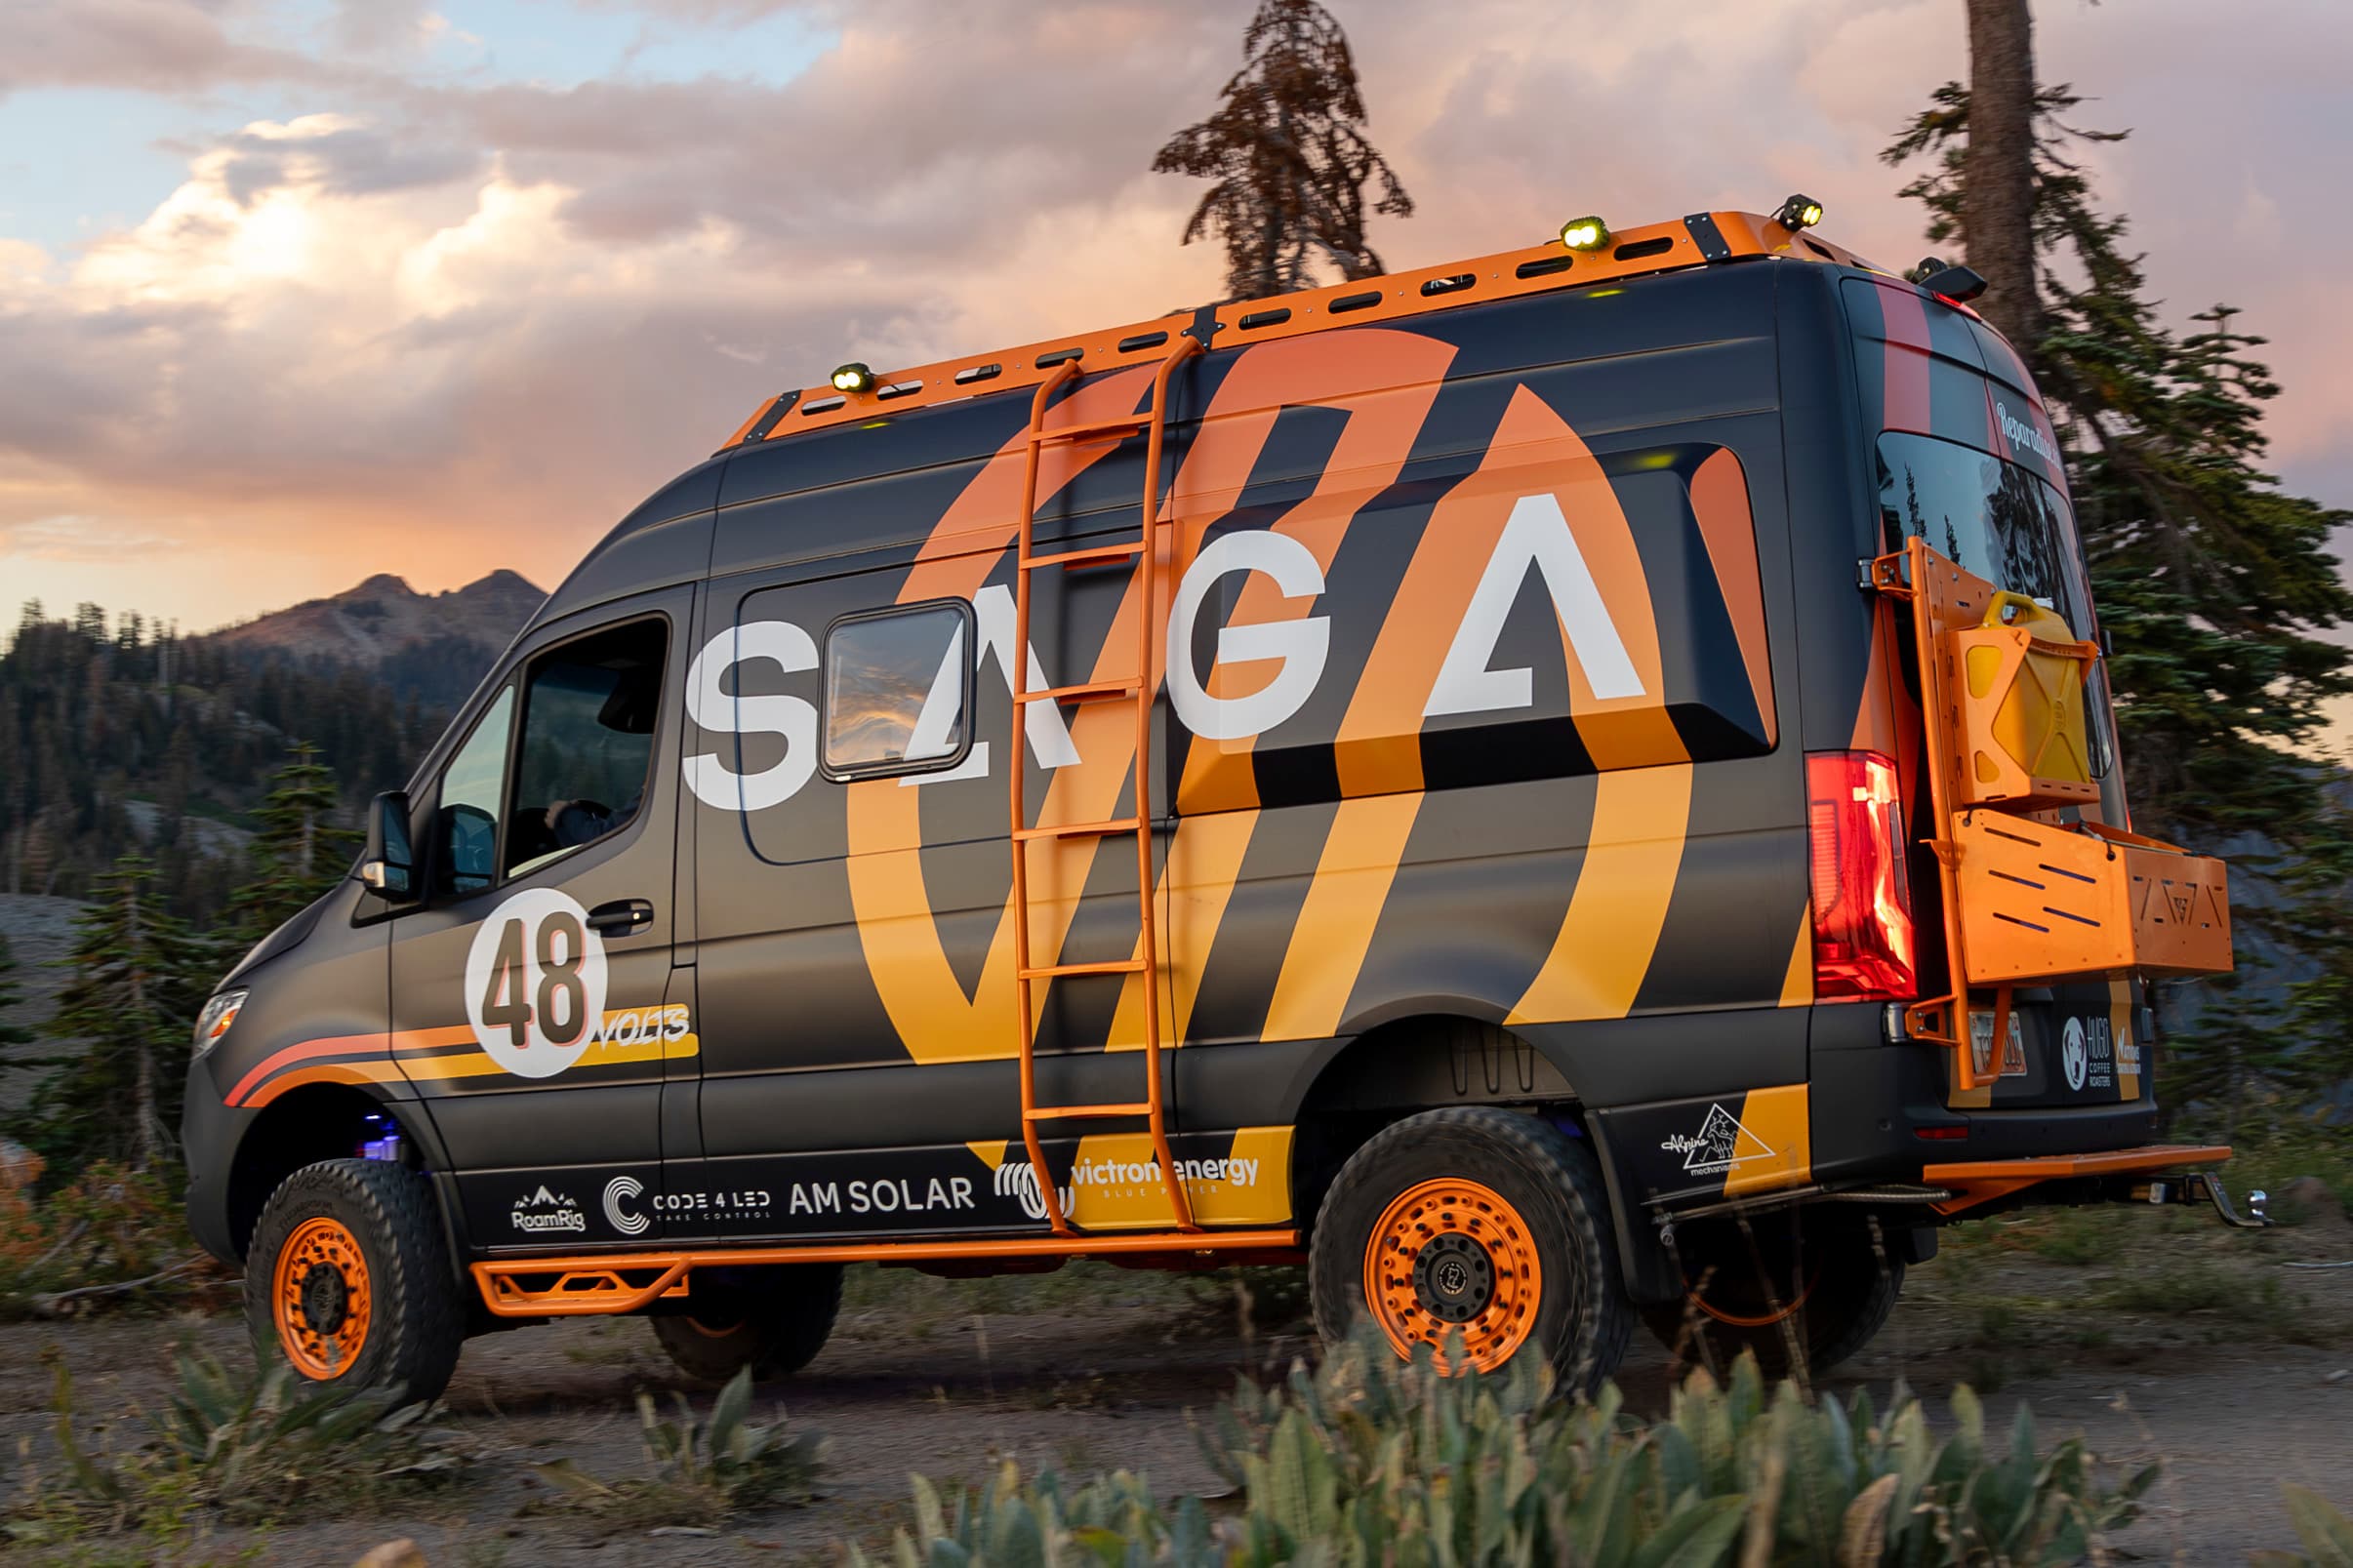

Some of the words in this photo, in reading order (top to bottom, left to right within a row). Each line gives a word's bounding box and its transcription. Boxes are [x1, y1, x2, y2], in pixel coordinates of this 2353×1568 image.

[683, 493, 1646, 810] SAGA
[481, 910, 588, 1049] 48
[594, 1008, 690, 1051] VOLTS
[2089, 1062, 2111, 1073] COFFEE
[1661, 1134, 1709, 1153] Alpine
[1071, 1158, 1162, 1186] victron
[1172, 1157, 1258, 1186] energy
[652, 1192, 708, 1211] CODE
[714, 1191, 726, 1208] 4
[733, 1190, 771, 1207] LED
[789, 1183, 841, 1215] AM
[850, 1177, 976, 1212] SOLAR
[1103, 1188, 1147, 1198] BLUE
[510, 1210, 586, 1233] RoamRig
[656, 1212, 691, 1222] TAKE
[703, 1211, 771, 1221] CONTROL
